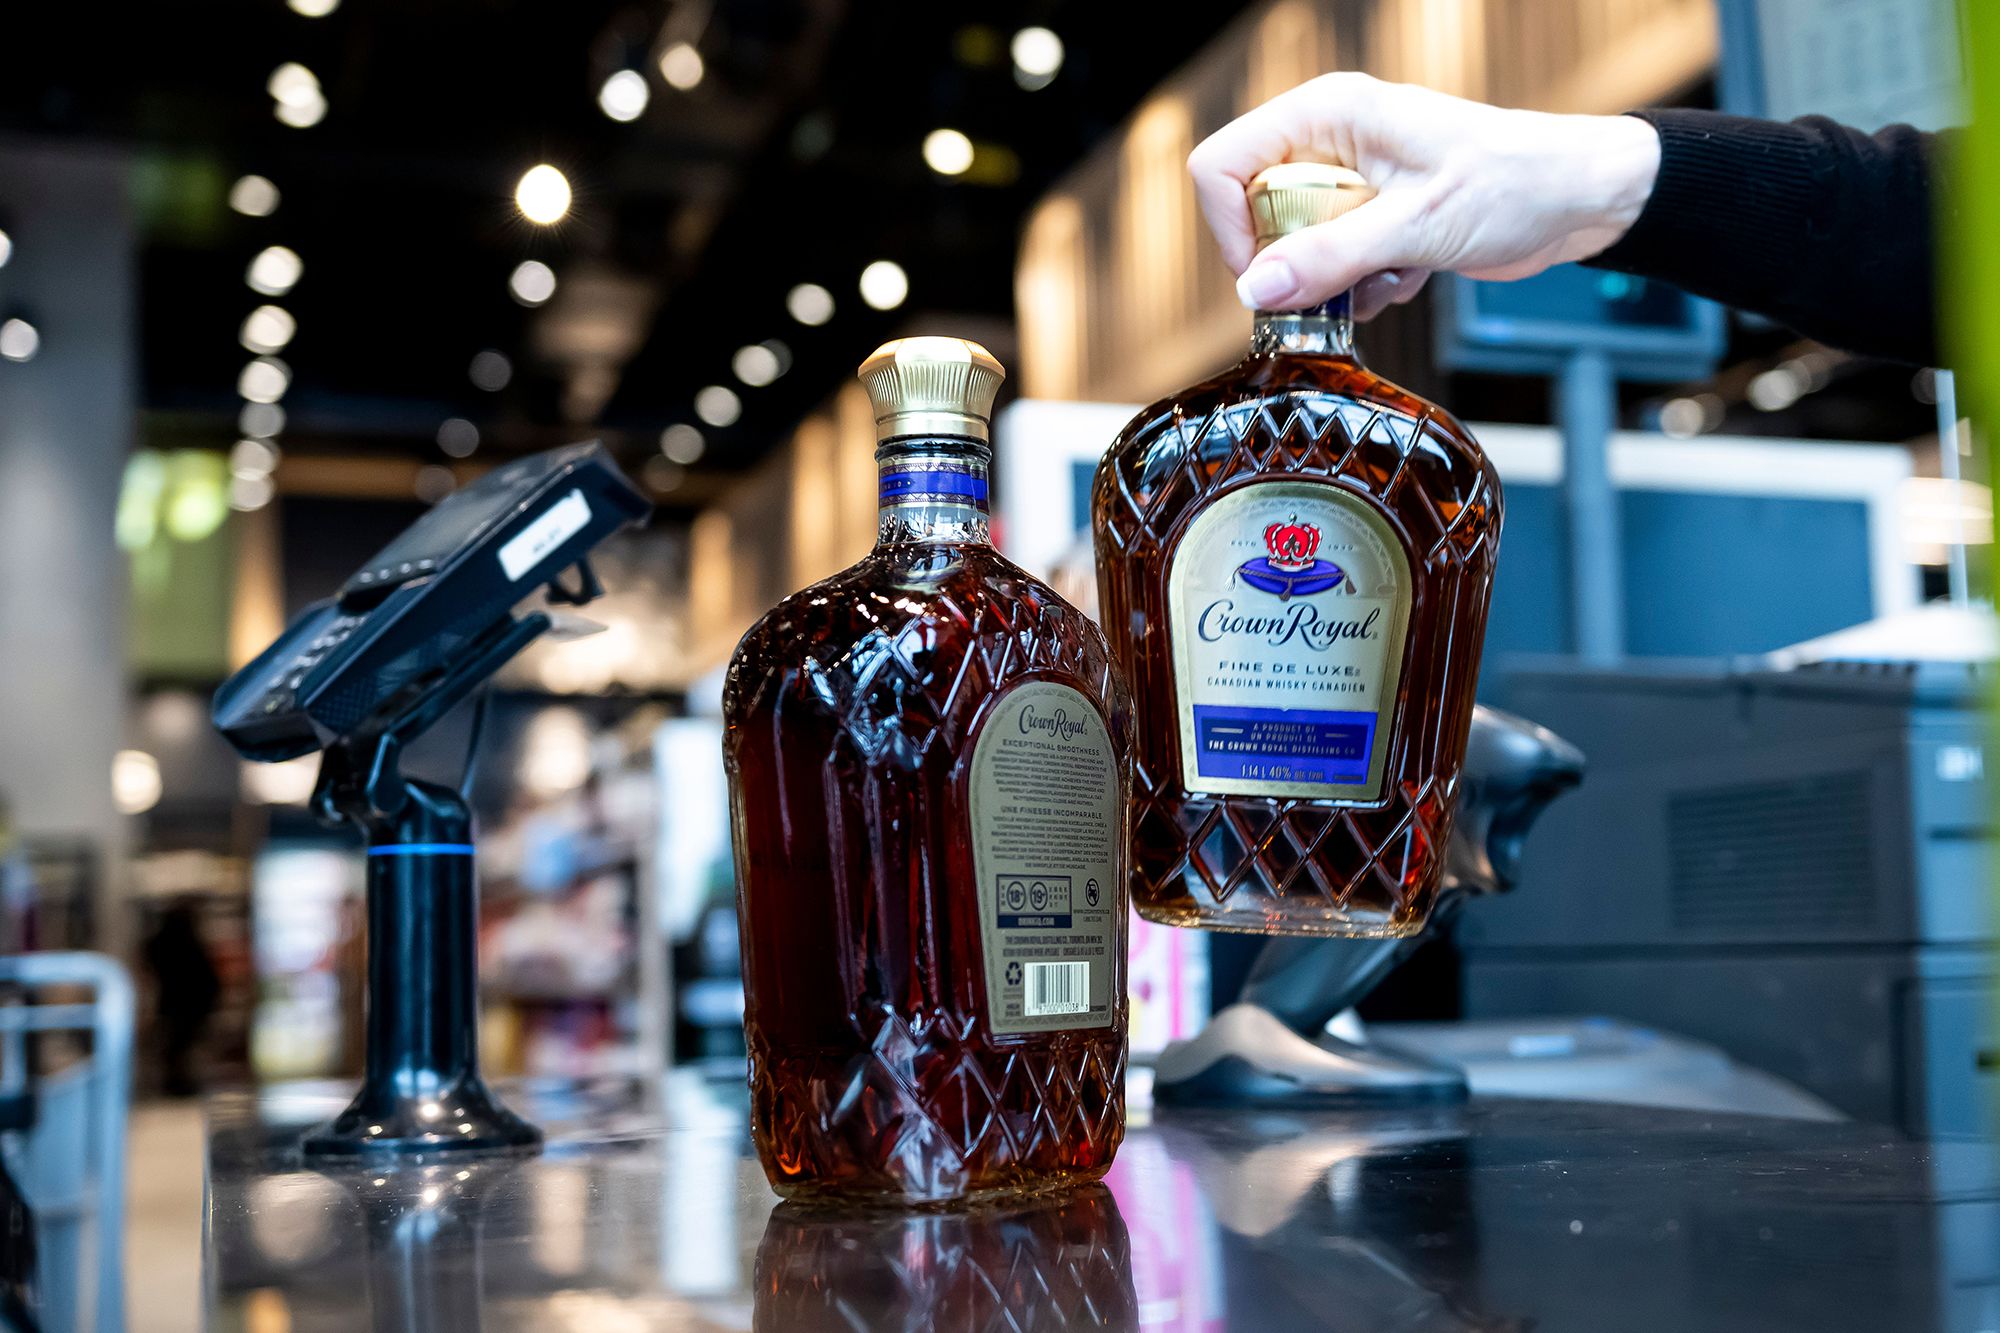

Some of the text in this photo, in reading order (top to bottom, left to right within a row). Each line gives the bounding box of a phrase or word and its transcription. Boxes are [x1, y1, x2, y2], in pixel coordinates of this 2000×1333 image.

[1198, 599, 1381, 651] Crown Royal
[1219, 661, 1355, 677] FINE DE LUXE
[1207, 677, 1366, 693] CANADIAN WHISKY CANADIEN
[1019, 704, 1087, 741] Crown Royal
[1262, 724, 1301, 733] PRODUCT
[1266, 733, 1303, 742] PRODUIT
[1002, 739, 1100, 756] EXCEPTIONAL SMOOTHNESS
[1209, 740, 1224, 750] THE
[1228, 741, 1258, 751] CROWN
[1262, 743, 1288, 753] ROYAL
[1292, 744, 1340, 755] DISTILLING
[1242, 764, 1258, 778] 1.14
[1269, 766, 1292, 779] 40%
[1001, 806, 1103, 820] UNE FINESSE INCOMPARABLE
